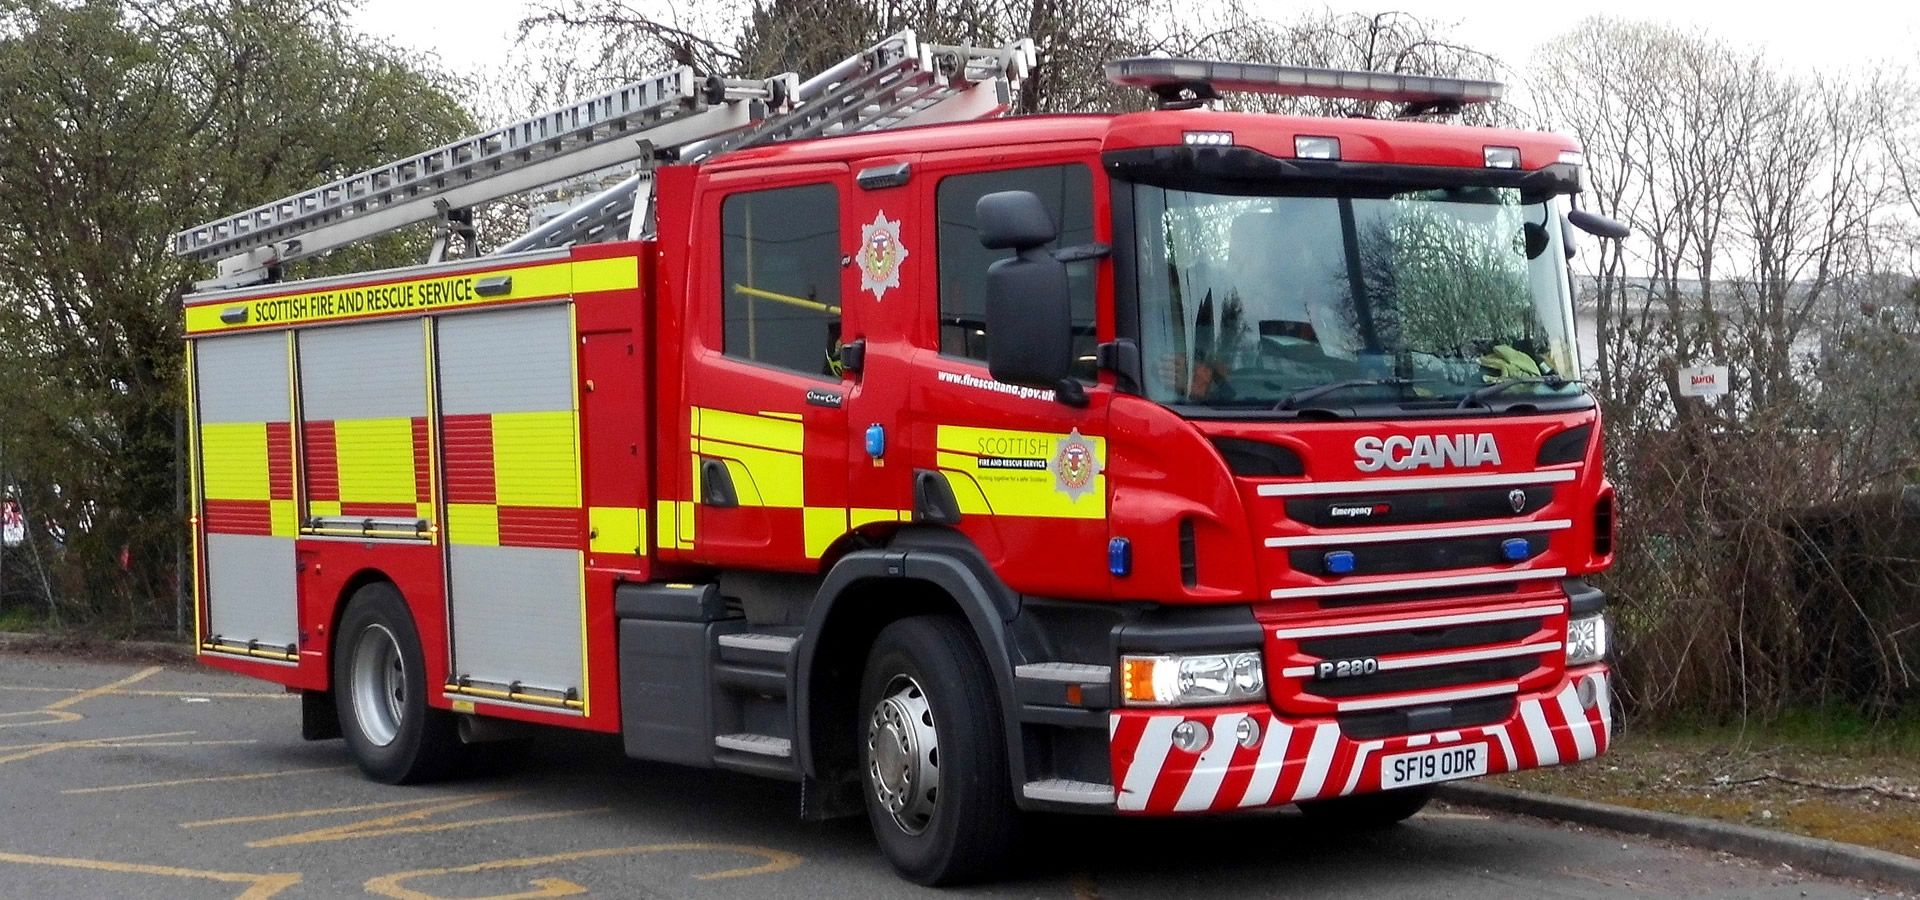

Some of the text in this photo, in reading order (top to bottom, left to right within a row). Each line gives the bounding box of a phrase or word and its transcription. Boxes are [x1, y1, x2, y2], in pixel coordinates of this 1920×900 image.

[256, 278, 472, 321] SCOTTISH FIRE AND RESCUE SERVICE
[938, 371, 1056, 401] www.firescotland.gov.uk
[978, 437, 1048, 455] SCOTTISH
[1354, 432, 1501, 472] SCANIA
[979, 458, 1046, 468] FIRE AND RESCUE SERVICE
[1320, 658, 1377, 678] P 280
[1394, 748, 1476, 782] SF19 ODR
